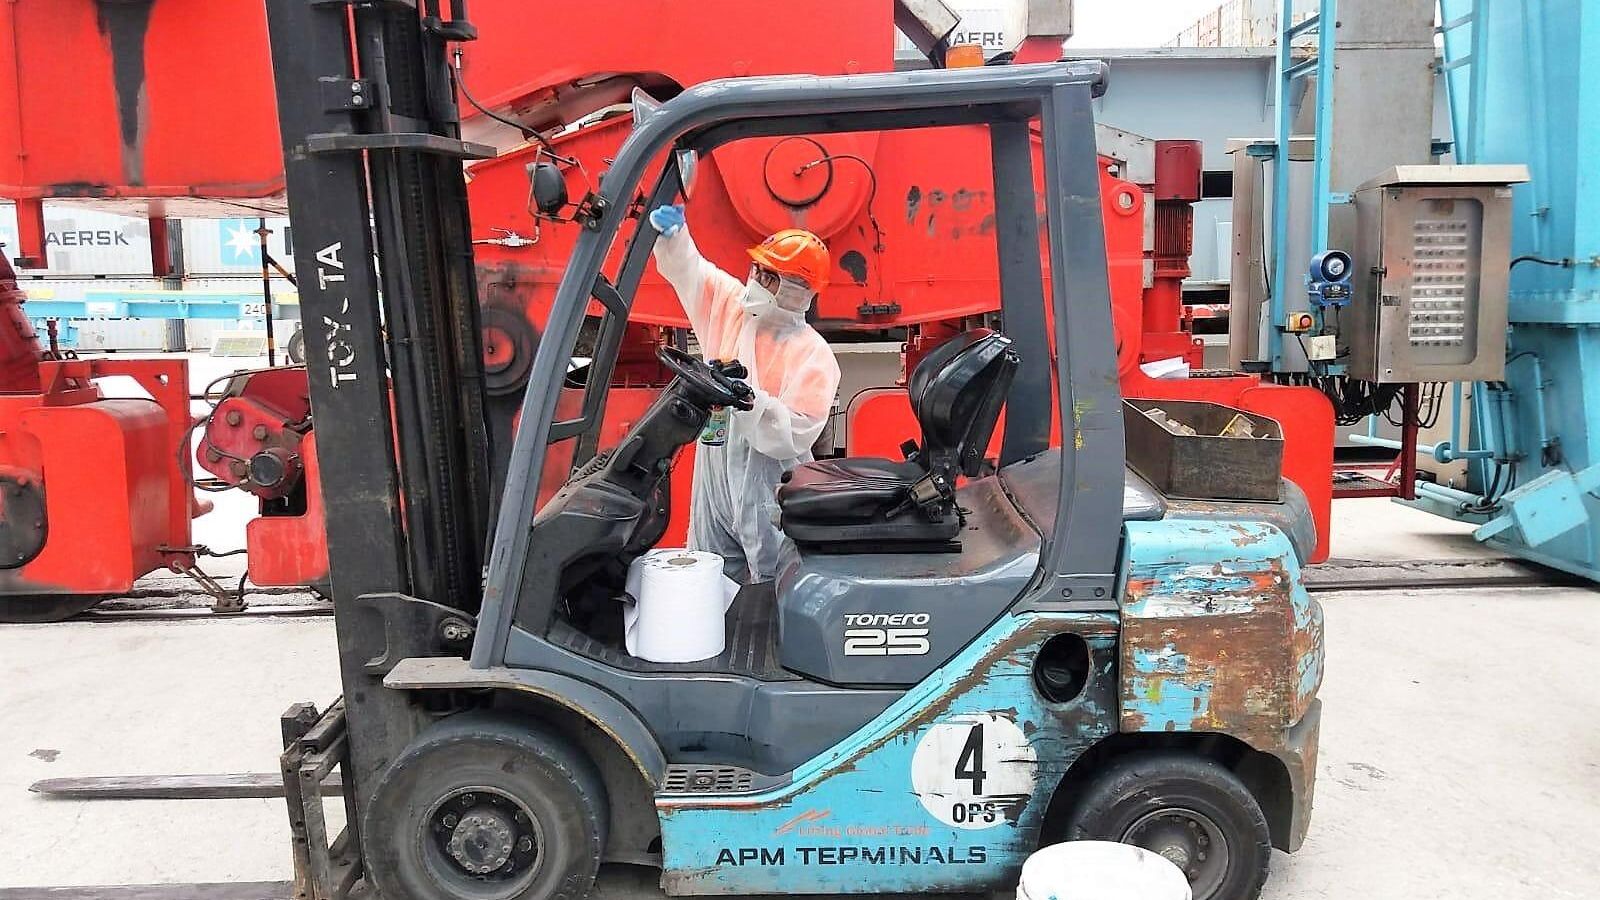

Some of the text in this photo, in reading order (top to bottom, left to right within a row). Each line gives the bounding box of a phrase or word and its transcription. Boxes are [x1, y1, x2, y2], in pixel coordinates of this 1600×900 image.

[46, 229, 129, 246] AERSK
[316, 241, 357, 389] TOYTA
[844, 613, 930, 626] TONERO
[844, 628, 930, 656] 25
[954, 723, 987, 796] 4
[952, 802, 996, 824] OPS
[715, 848, 785, 866] APM
